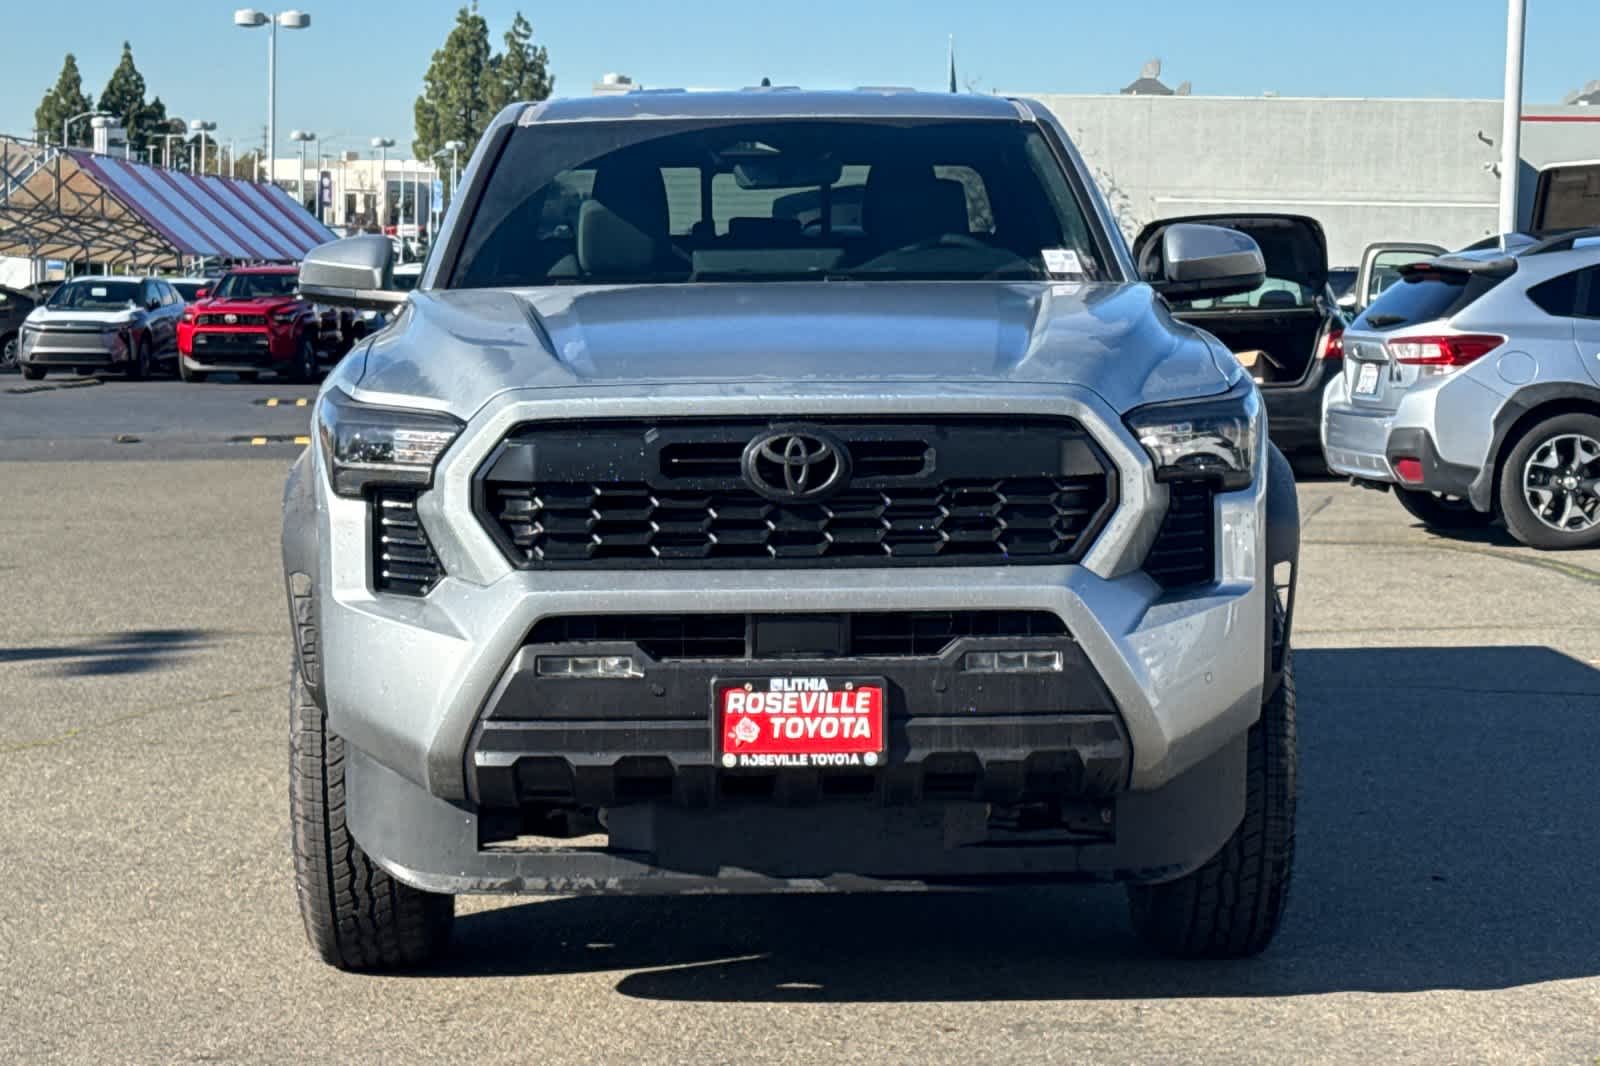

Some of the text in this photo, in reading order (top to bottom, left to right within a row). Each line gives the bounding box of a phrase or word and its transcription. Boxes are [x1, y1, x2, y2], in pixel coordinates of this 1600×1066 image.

[784, 678, 829, 691] LITHIA
[727, 691, 871, 714] ROSEVILLE
[770, 716, 871, 739] TOYOTA
[740, 753, 860, 767] ROSEVILLE TOYOTA
